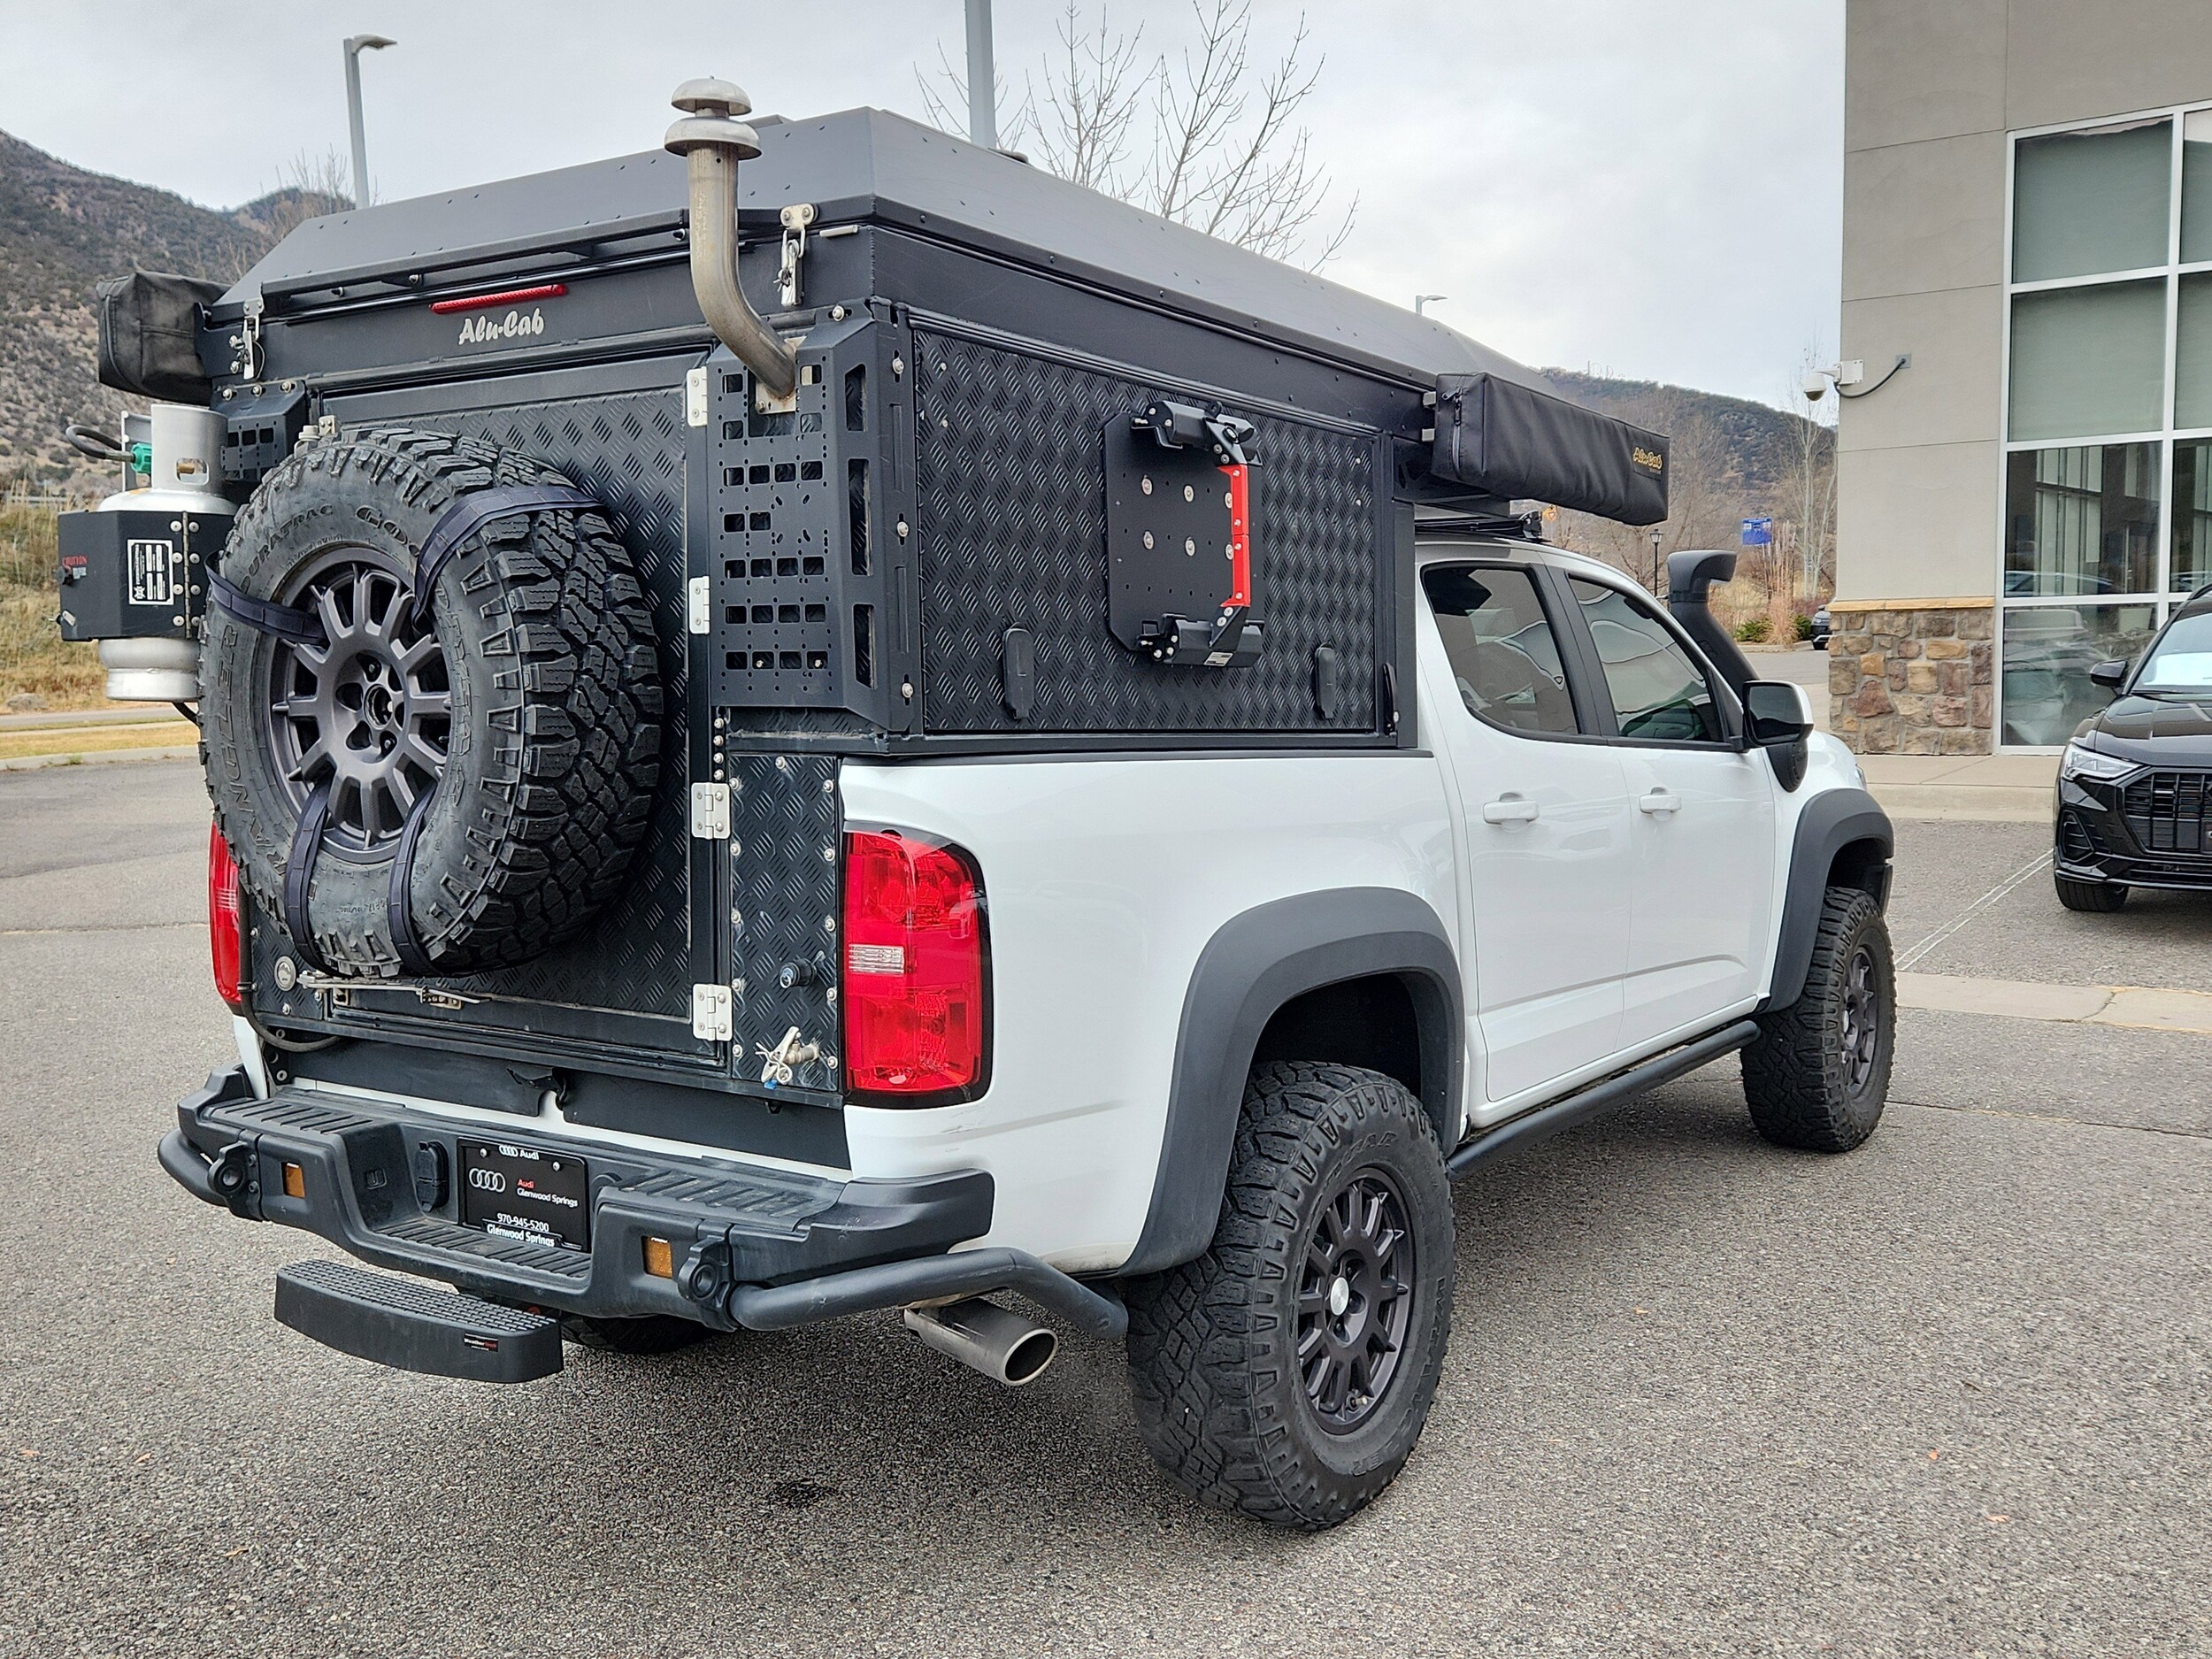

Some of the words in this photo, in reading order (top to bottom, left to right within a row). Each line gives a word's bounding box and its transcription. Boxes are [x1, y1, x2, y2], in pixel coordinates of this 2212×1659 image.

[458, 307, 544, 345] Alu-Cab
[519, 1150, 539, 1160] Audi
[518, 1179, 534, 1188] Audi
[517, 1188, 551, 1202] Glenwood
[552, 1194, 578, 1208] Springs
[497, 1213, 549, 1232] 970-945-5200
[488, 1224, 525, 1240] Glenwood
[526, 1231, 556, 1248] Springs
